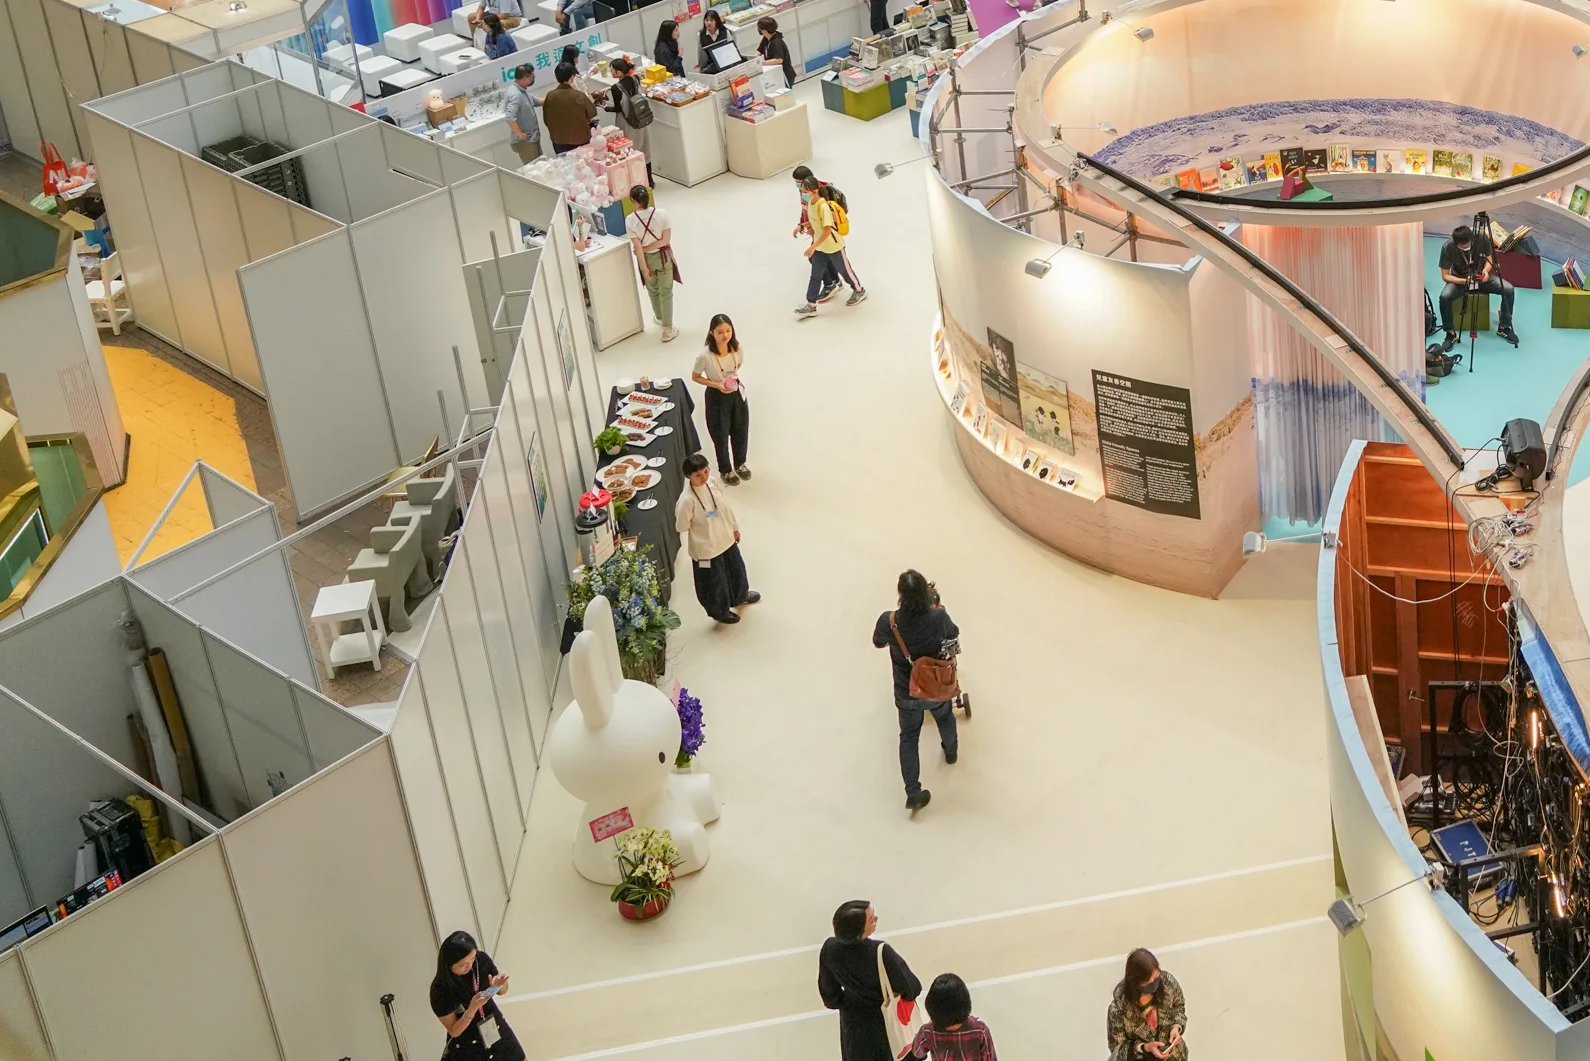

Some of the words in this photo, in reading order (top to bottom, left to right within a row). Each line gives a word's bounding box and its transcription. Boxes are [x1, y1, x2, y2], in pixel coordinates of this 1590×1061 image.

[1096, 374, 1132, 388] 兒童友善空間
